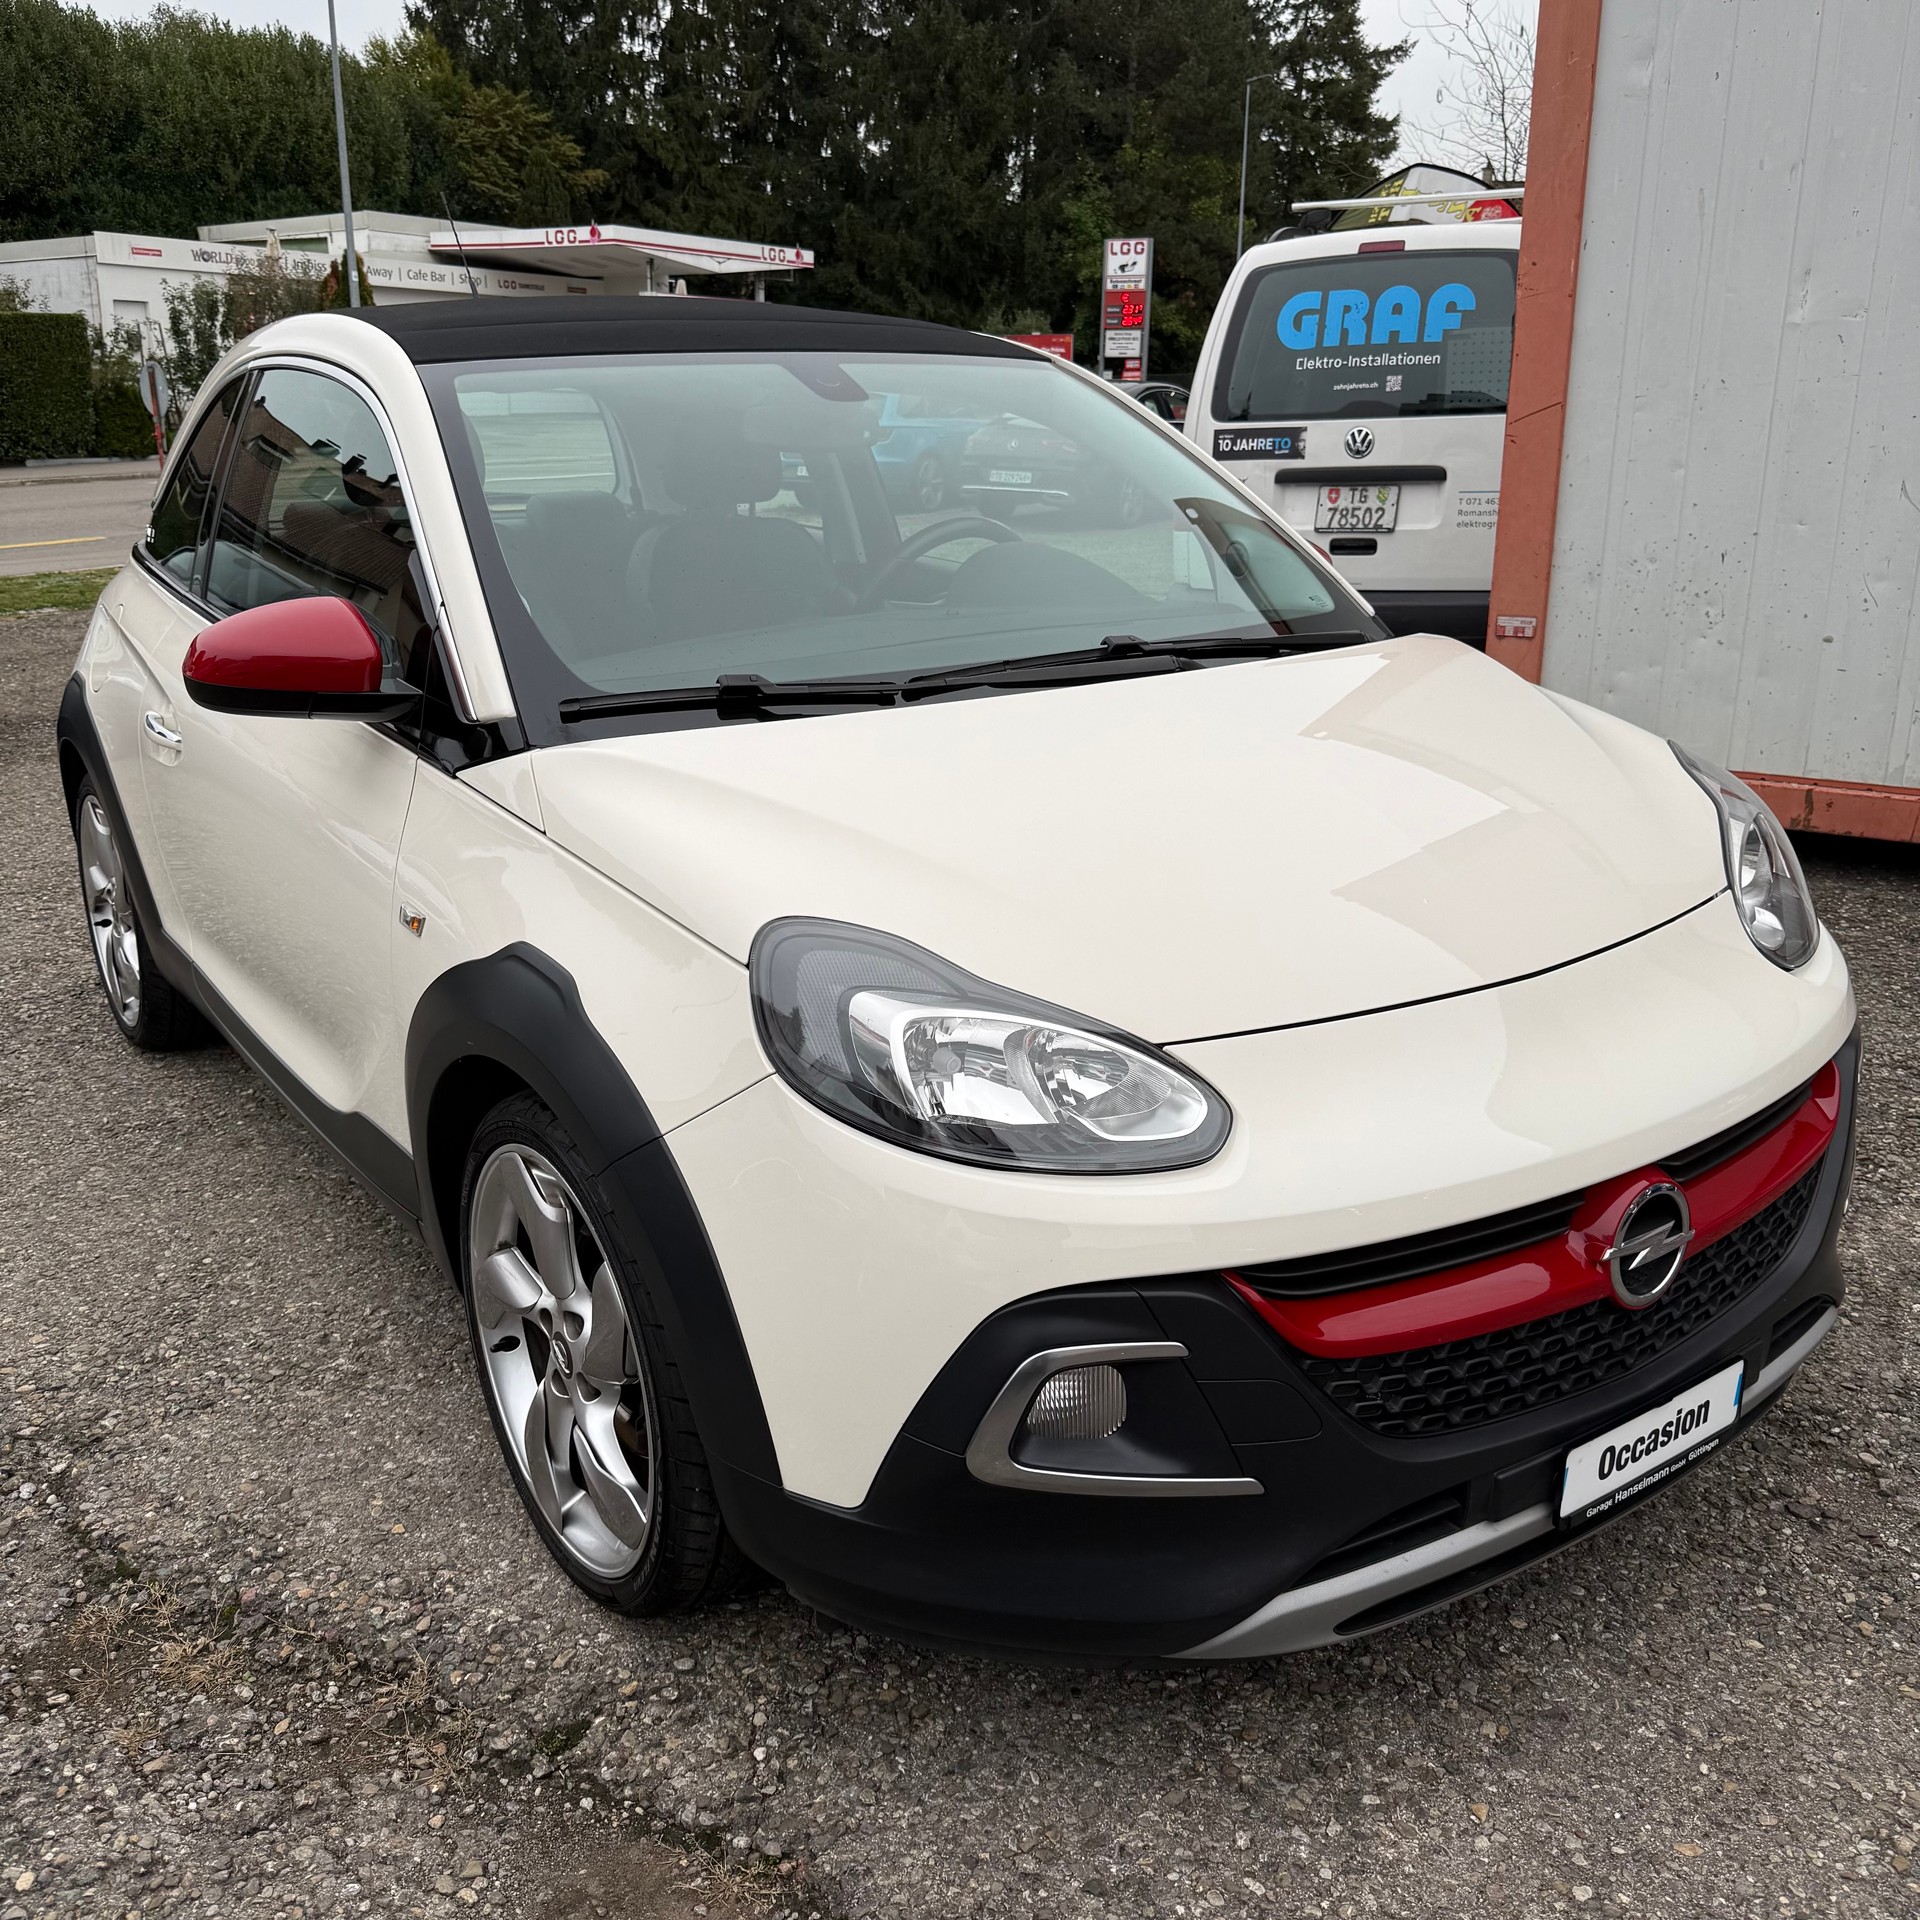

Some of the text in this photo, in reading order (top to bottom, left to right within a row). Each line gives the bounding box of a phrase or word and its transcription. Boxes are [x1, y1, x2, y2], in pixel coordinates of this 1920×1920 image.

[545, 229, 577, 245] LGG
[761, 246, 786, 263] LGG
[1110, 241, 1145, 256] LGG
[366, 265, 482, 286] Away Cafe Bar Shop
[1276, 283, 1476, 350] GRAF
[1296, 352, 1440, 370] Elektro-Installationen
[1218, 439, 1231, 452] 10
[1349, 487, 1368, 504] TG
[1458, 497, 1465, 505] T
[1465, 497, 1482, 505] 071
[1327, 507, 1385, 528] 78502
[1598, 1399, 1711, 1480] Occasion
[1586, 1498, 1613, 1518] Garage
[1614, 1466, 1670, 1504] Hanselmann
